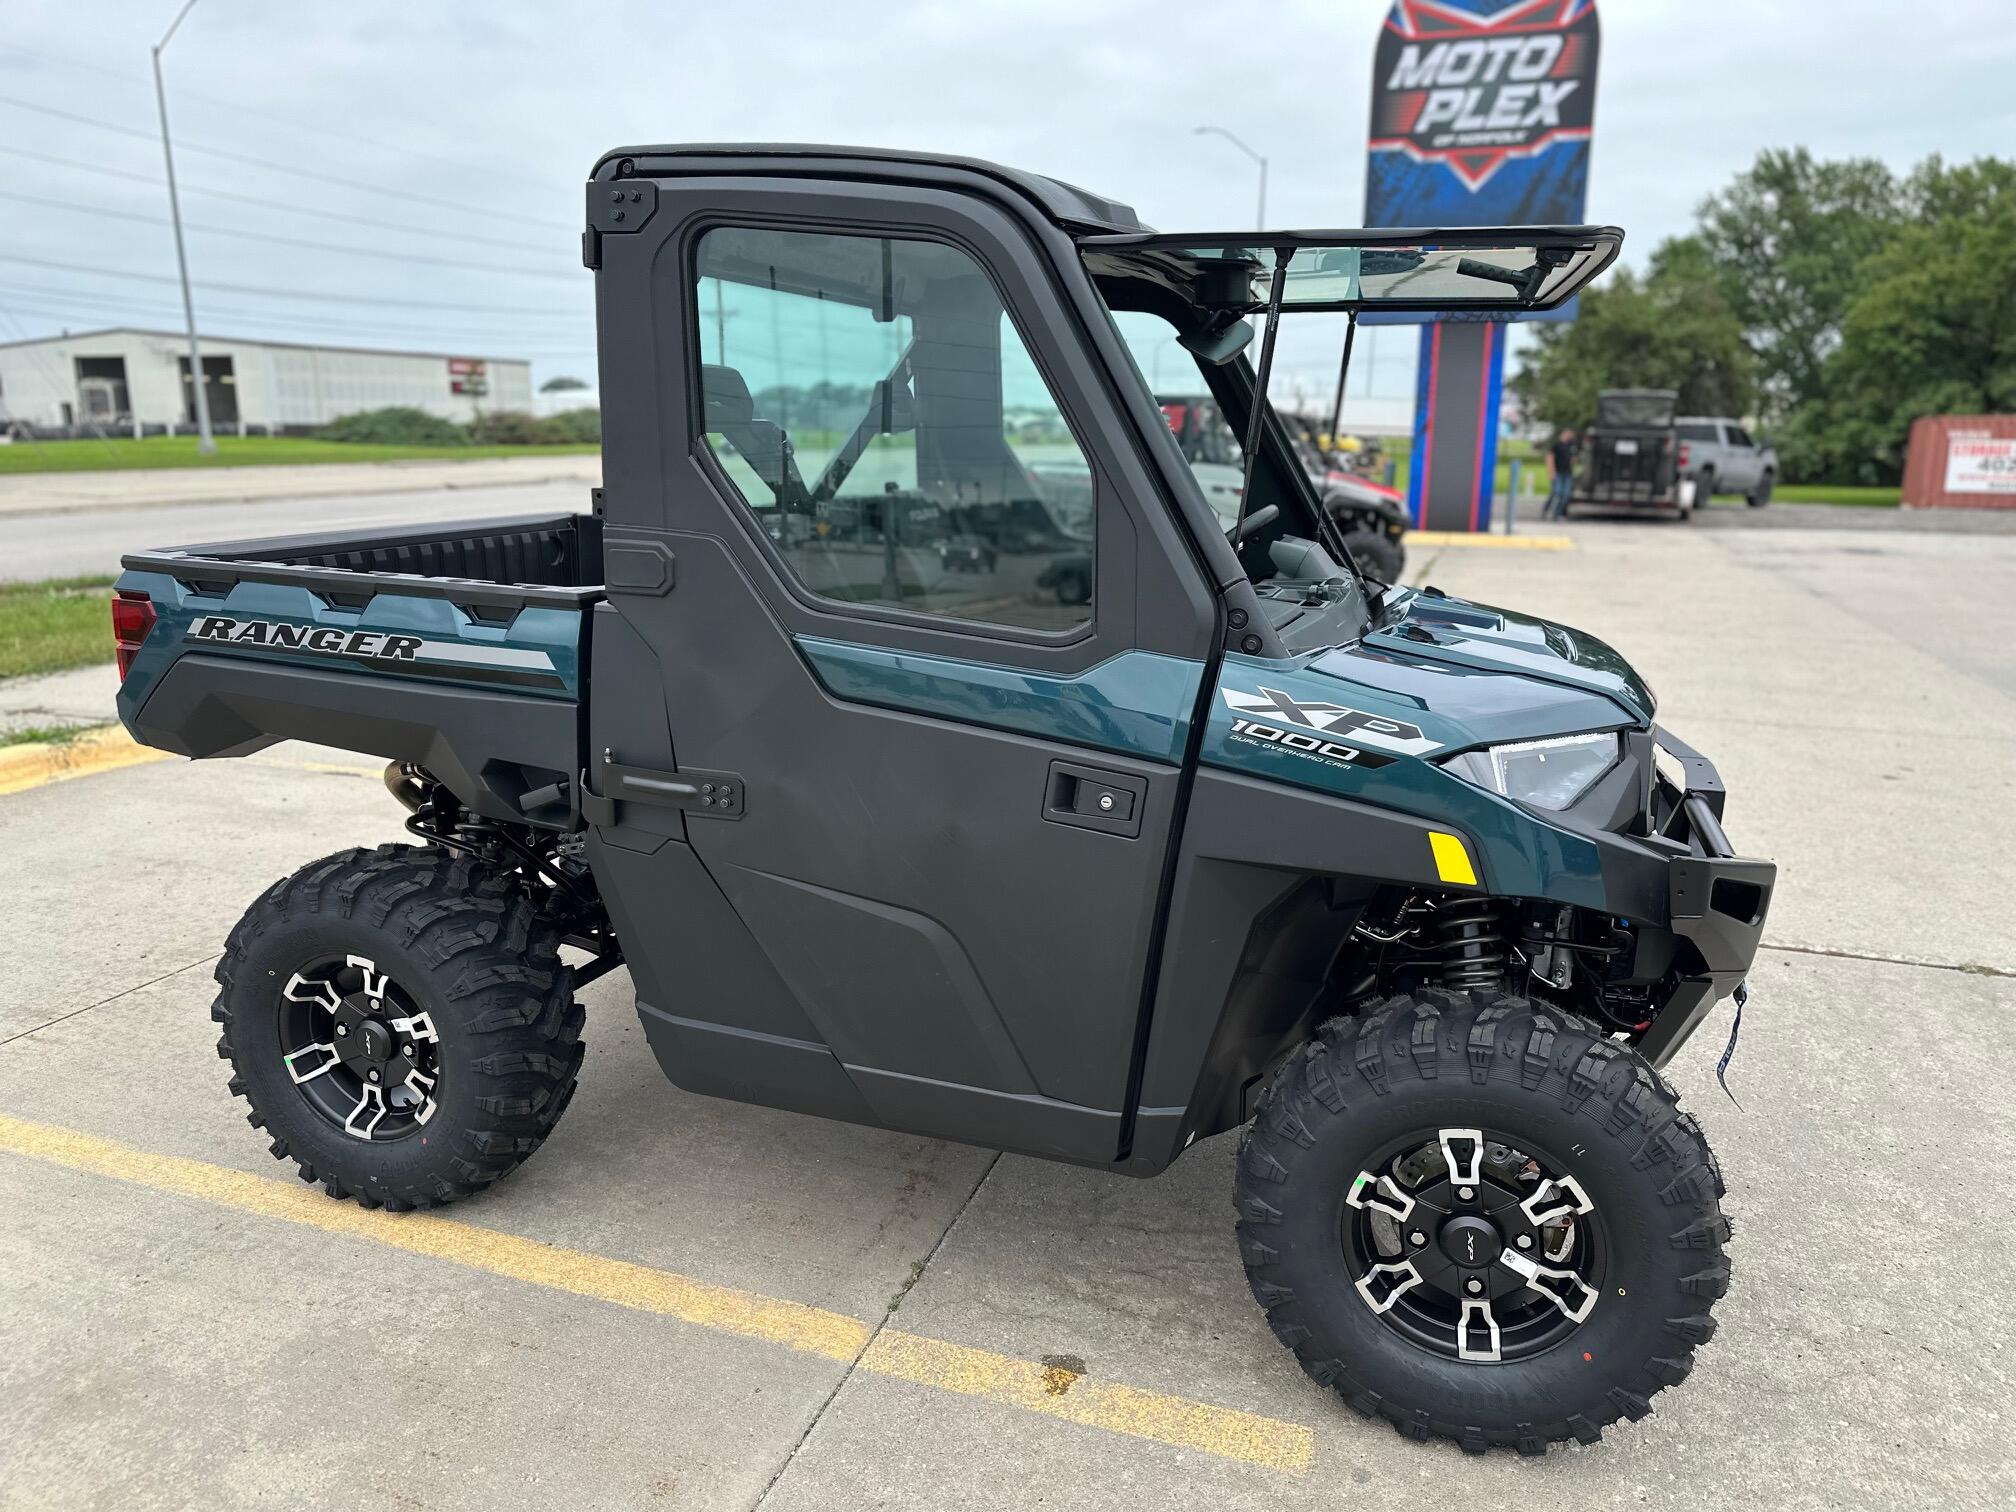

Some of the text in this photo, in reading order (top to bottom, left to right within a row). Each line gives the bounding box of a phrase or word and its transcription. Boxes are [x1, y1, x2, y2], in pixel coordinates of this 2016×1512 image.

[1387, 34, 1563, 90] MOTO
[1414, 80, 1580, 133] PLEX
[195, 616, 423, 661] RANGER
[1229, 685, 1427, 738] XP
[1229, 734, 1351, 770] DUAL OVERHEAD CAM
[1230, 719, 1360, 761] 1000
